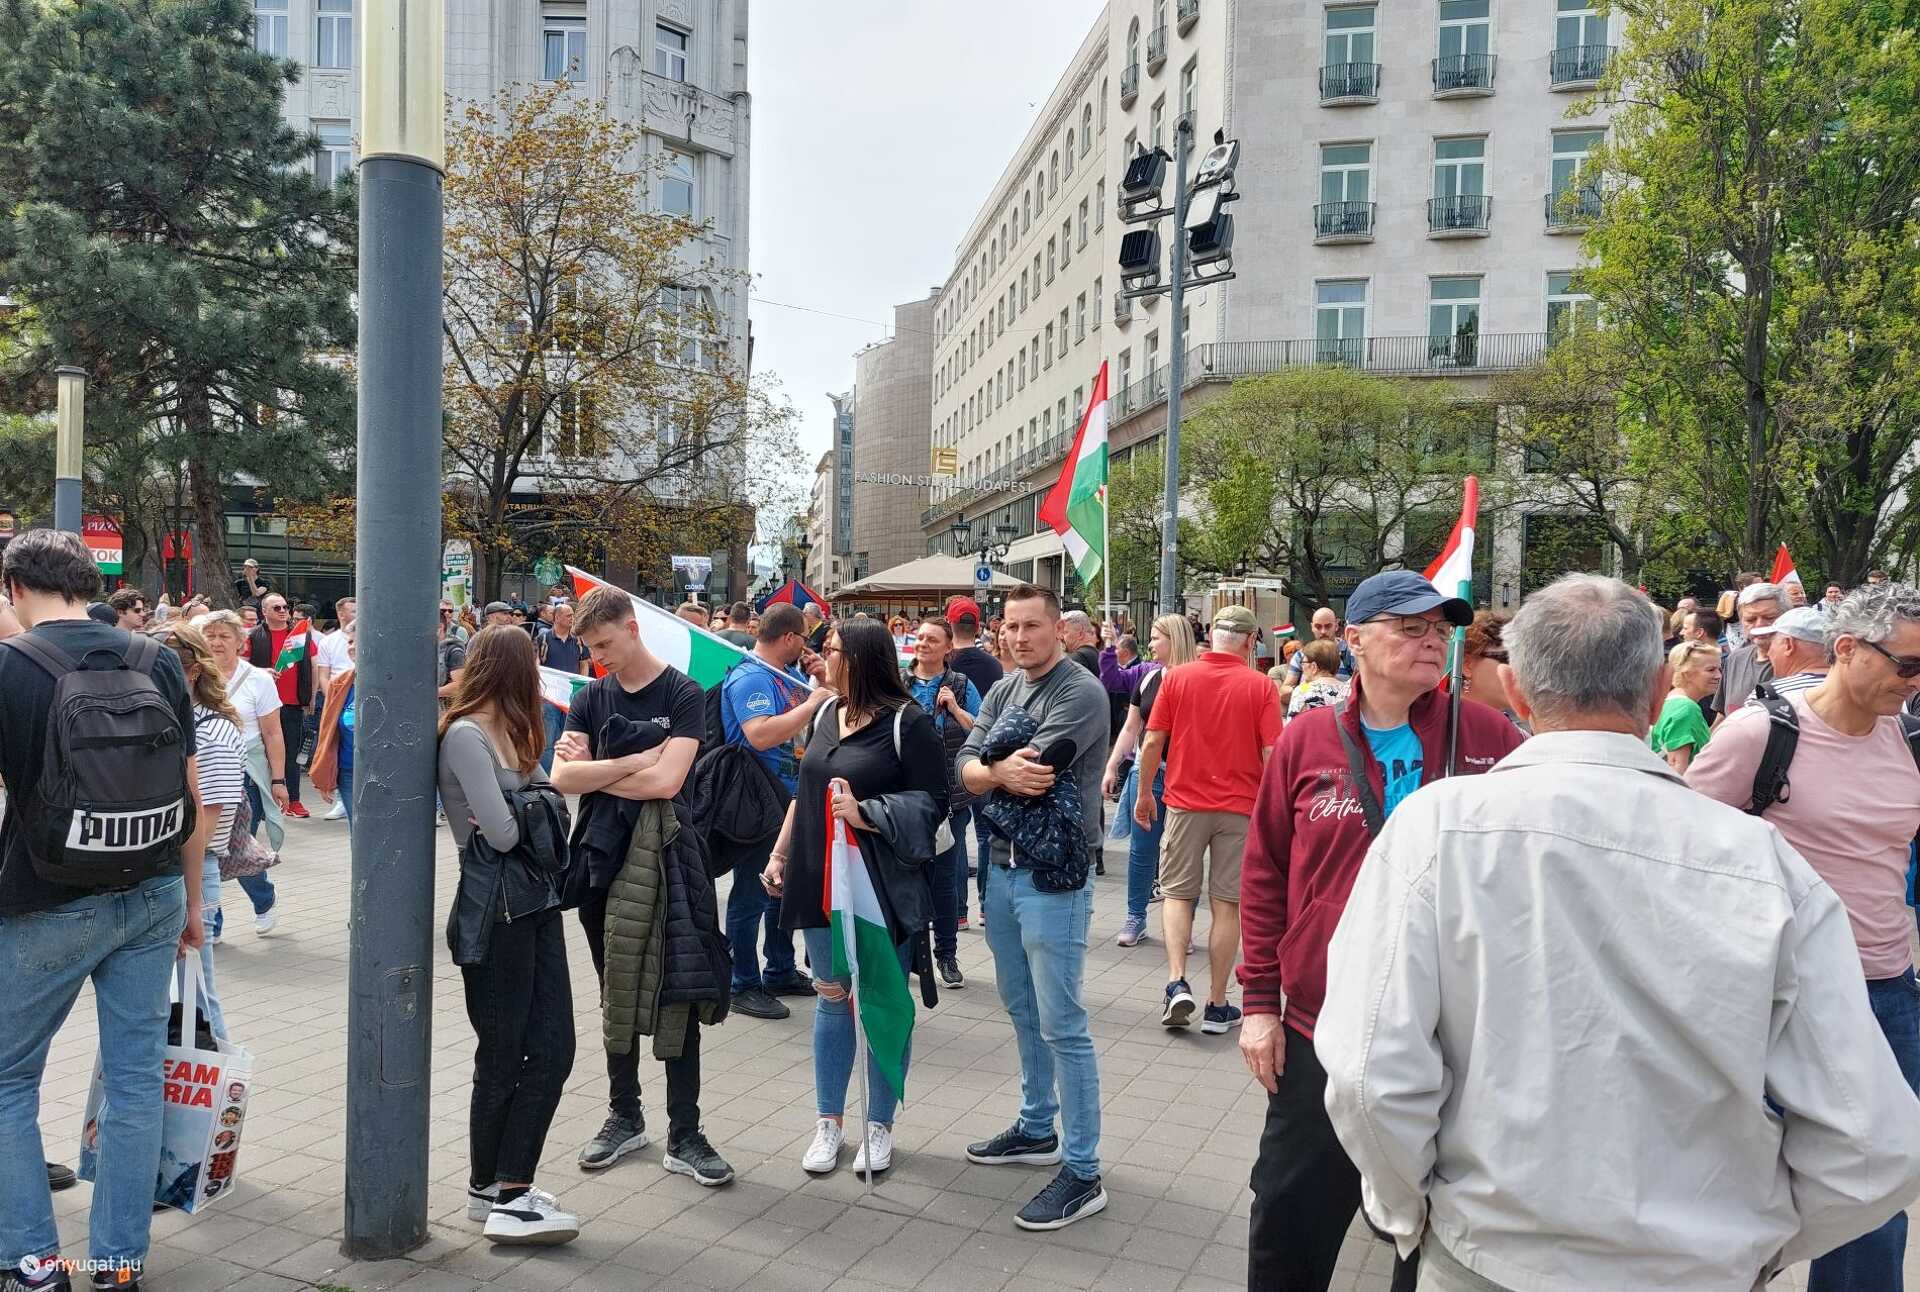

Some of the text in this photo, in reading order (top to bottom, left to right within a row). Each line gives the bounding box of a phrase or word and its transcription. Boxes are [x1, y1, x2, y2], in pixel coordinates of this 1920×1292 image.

[855, 471, 912, 486] FASHION
[965, 479, 1033, 493] BUDAPEST
[79, 805, 179, 846] PUMA
[163, 1059, 220, 1086] EAM
[163, 1082, 213, 1108] RIA
